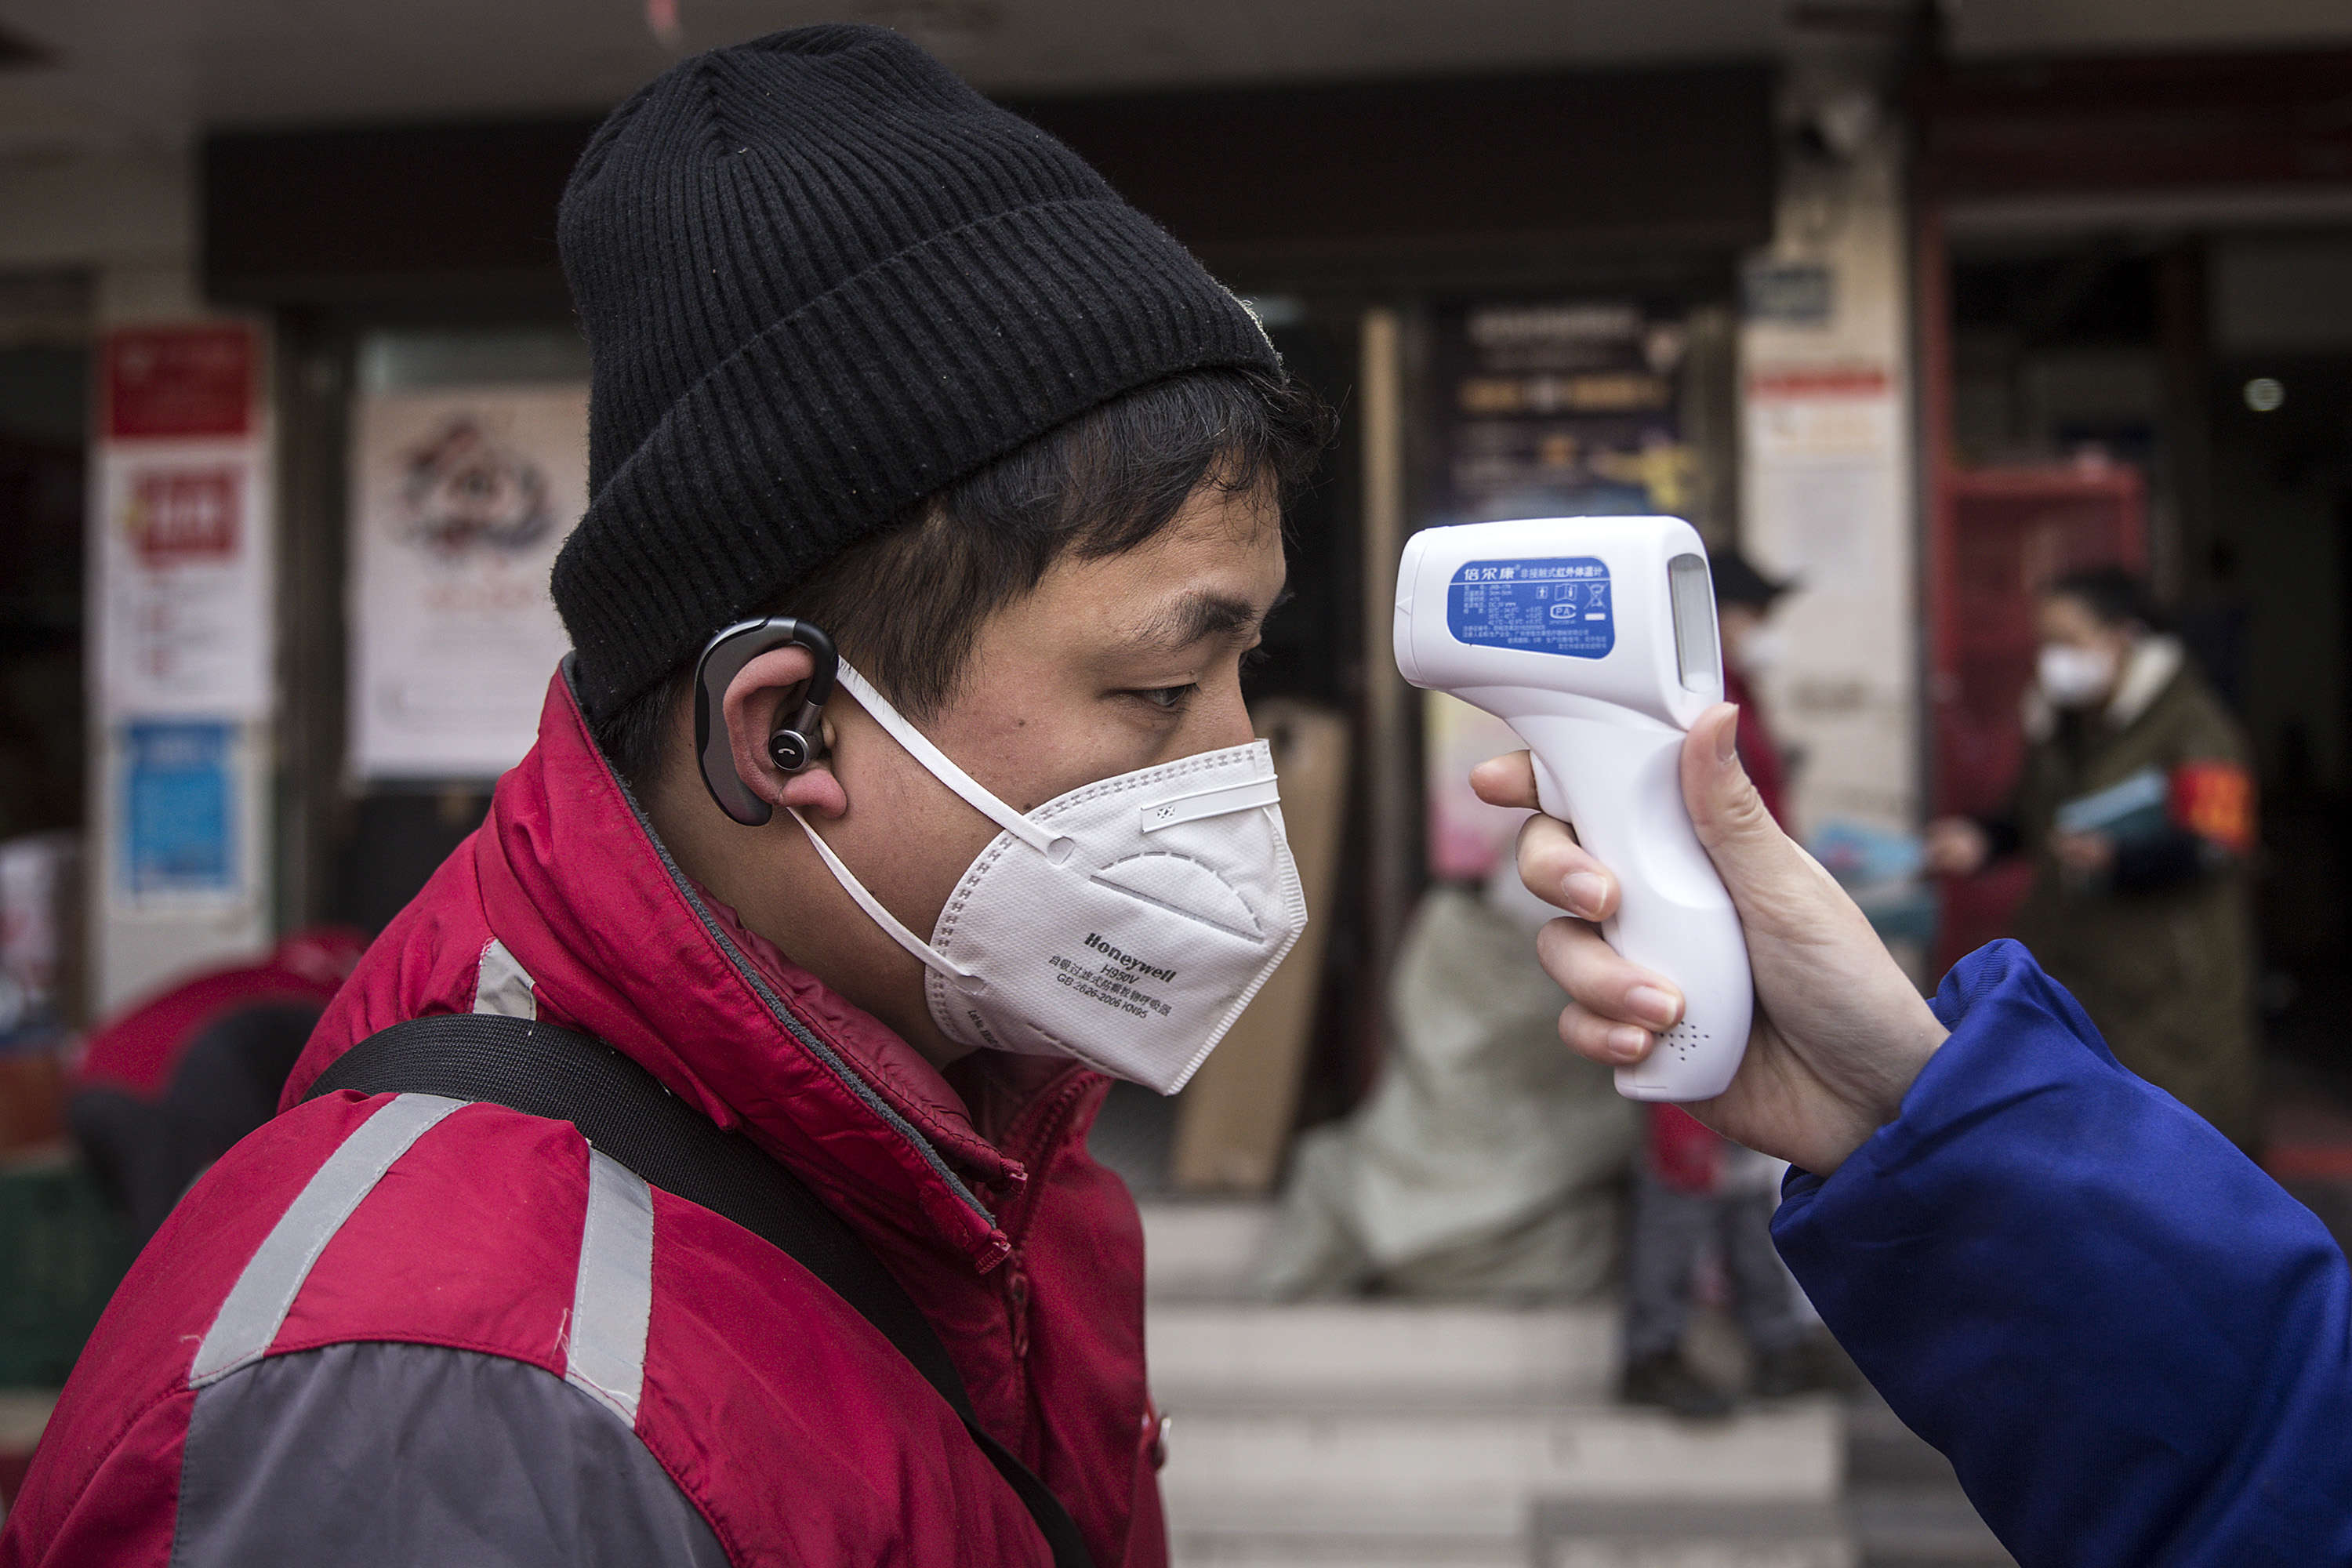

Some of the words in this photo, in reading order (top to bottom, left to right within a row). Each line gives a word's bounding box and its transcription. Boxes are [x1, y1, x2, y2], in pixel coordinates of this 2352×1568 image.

[1465, 568, 1514, 581] 倍尔康
[1520, 566, 1603, 579] 非接触式红外体温计
[1083, 932, 1177, 983] Honeywell
[1100, 964, 1141, 985] H950V
[1048, 954, 1173, 1017] 自吸过滤式防颗粒物呼吸器
[1056, 972, 1075, 986] GB
[1073, 980, 1123, 1008] 2626-2006
[1121, 1000, 1150, 1019] KN95
